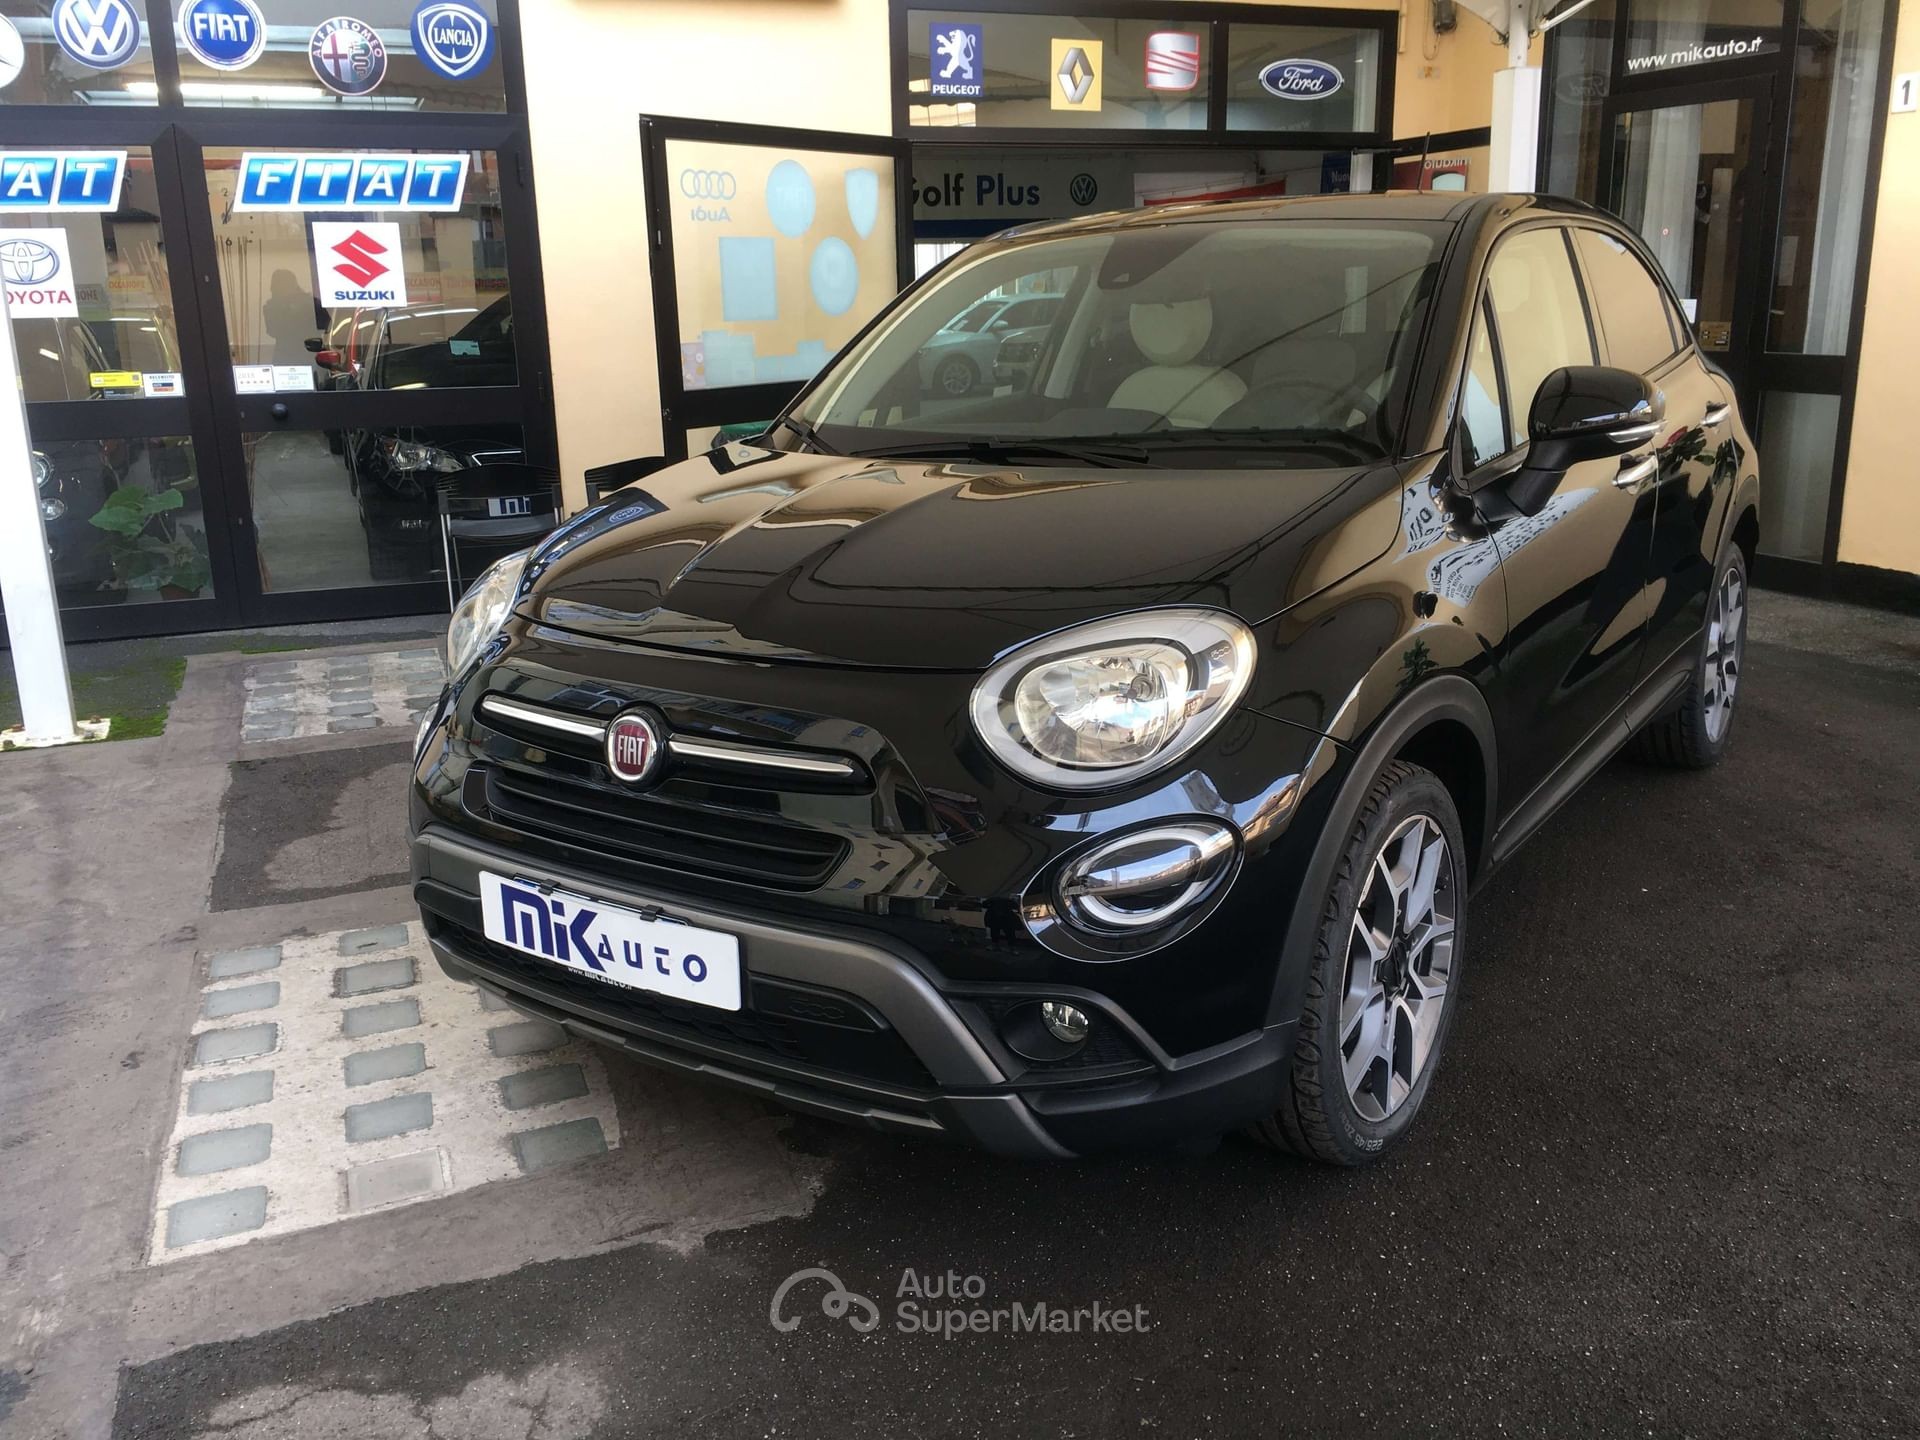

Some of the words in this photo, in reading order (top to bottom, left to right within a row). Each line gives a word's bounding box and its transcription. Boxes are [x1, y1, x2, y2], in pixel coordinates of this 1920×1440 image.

[193, 12, 250, 42] FIAT
[312, 24, 336, 58] ALFA
[341, 20, 383, 58] ROMEO
[433, 27, 474, 47] LANCIA
[932, 84, 981, 95] PEUGEOT
[1278, 66, 1325, 92] Ford
[1902, 79, 1911, 106] 1
[255, 162, 453, 198] FIAT
[912, 173, 964, 207] olf
[976, 173, 1040, 207] Plus
[334, 290, 395, 301] SUZUKI
[617, 734, 646, 766] FIAT
